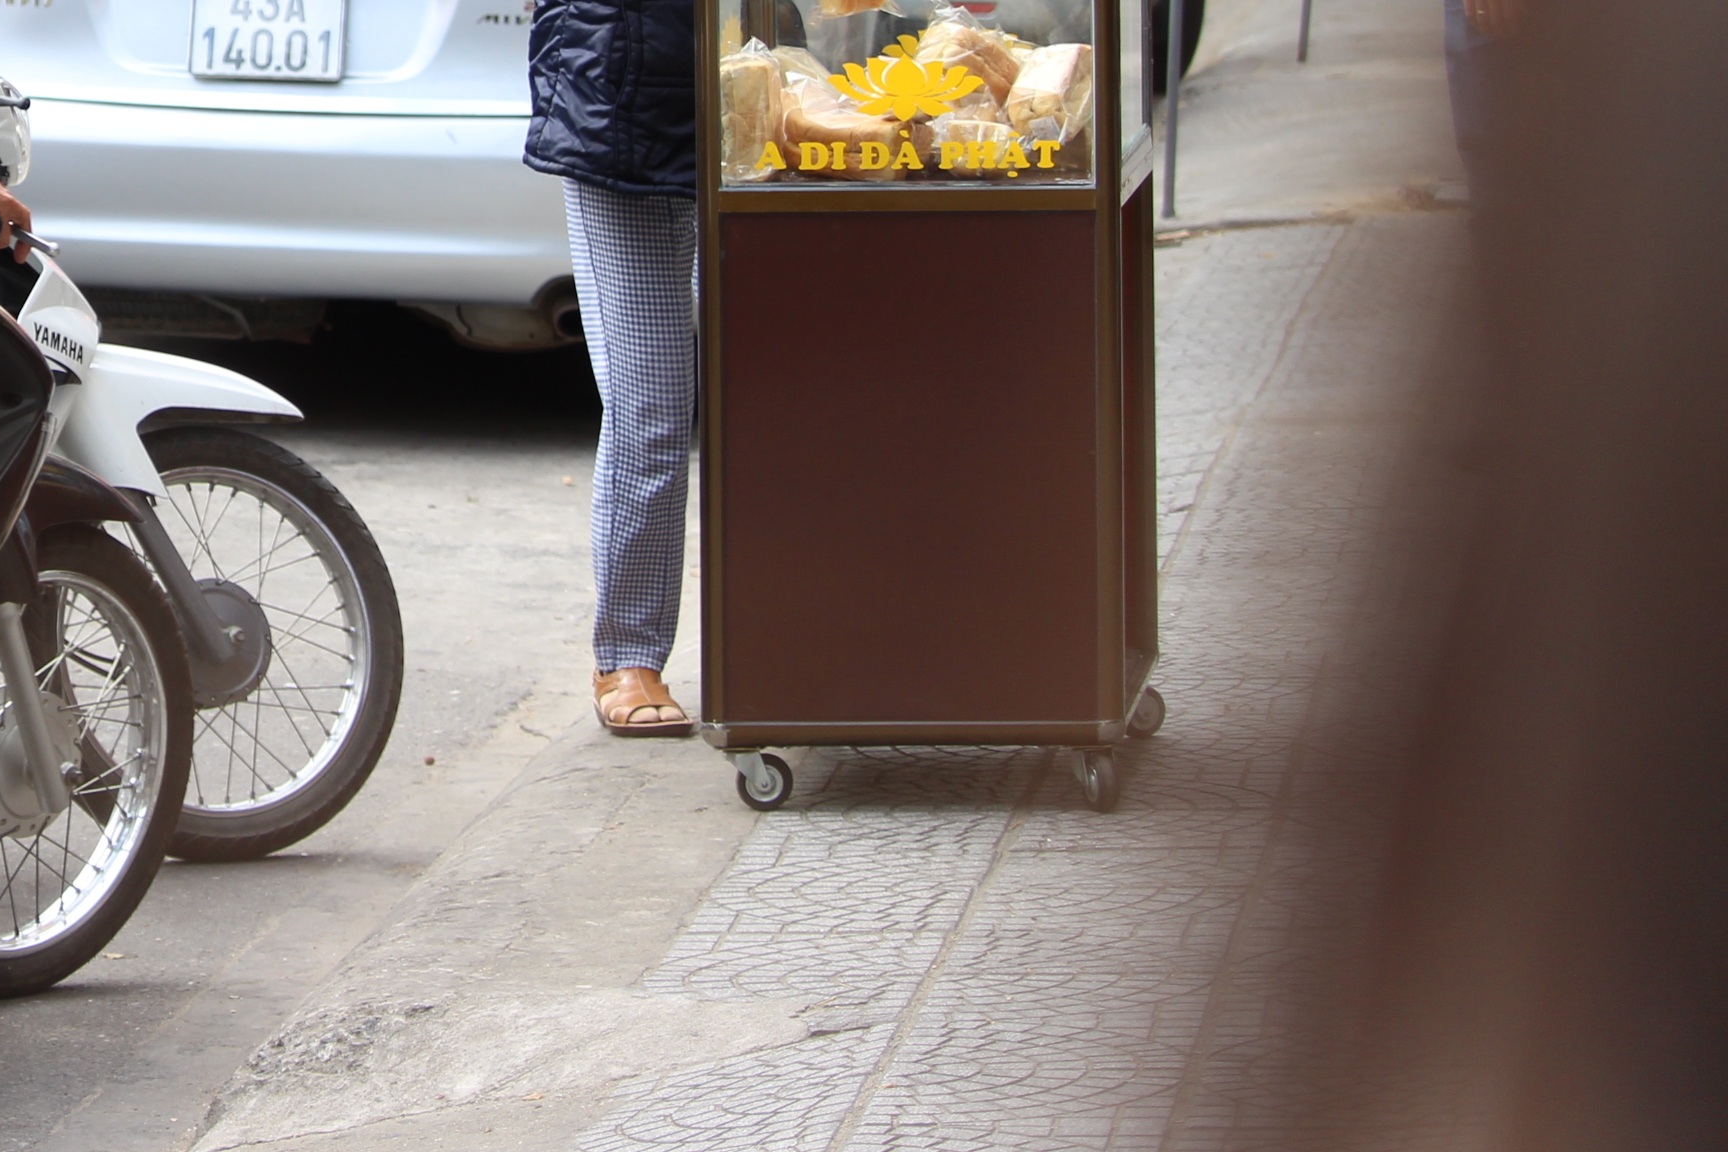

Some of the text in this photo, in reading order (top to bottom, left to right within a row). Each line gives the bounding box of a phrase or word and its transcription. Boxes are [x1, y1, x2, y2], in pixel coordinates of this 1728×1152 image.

[203, 29, 331, 75] 140.01
[755, 130, 1061, 178] A DI ĐÀ PHẬT
[34, 323, 84, 365] YAMAHA
